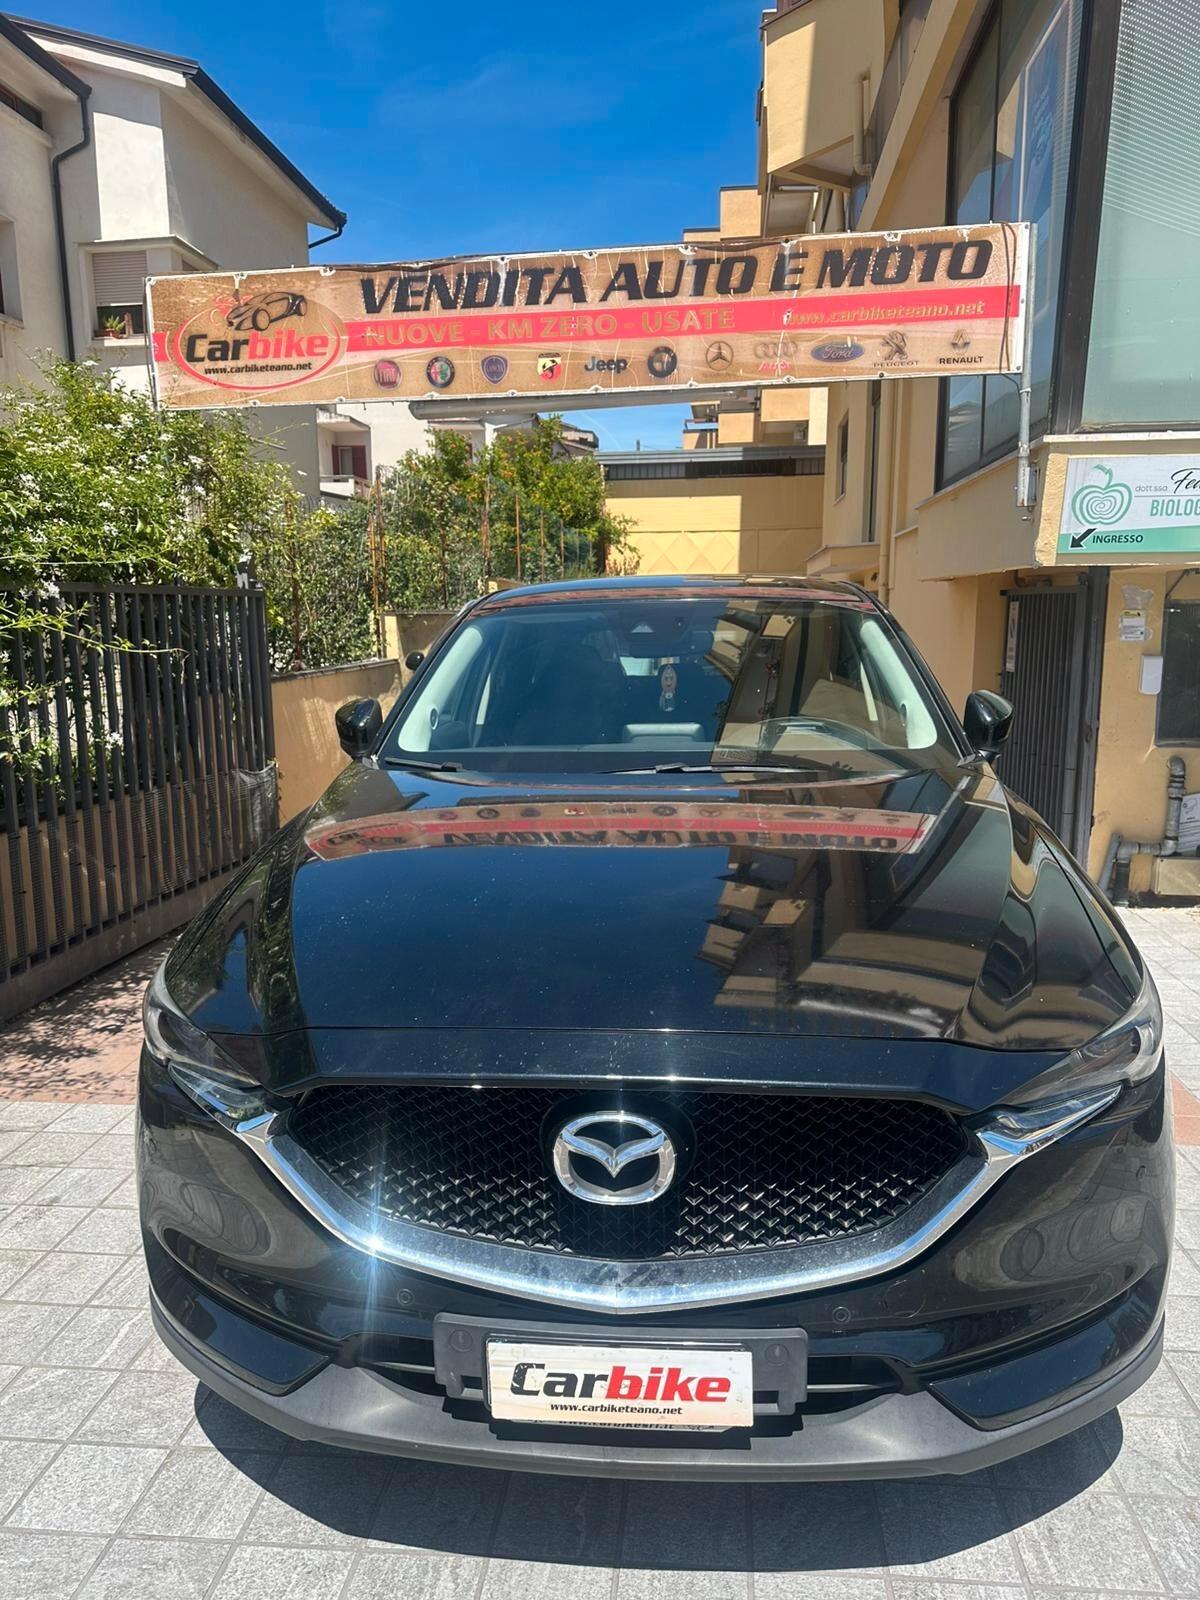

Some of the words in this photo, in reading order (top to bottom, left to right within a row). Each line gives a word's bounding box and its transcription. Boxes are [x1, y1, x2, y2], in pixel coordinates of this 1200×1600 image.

[360, 266, 587, 314] VENDITA
[599, 256, 758, 302] AUTO
[769, 250, 808, 292] E
[816, 239, 993, 289] MOTO
[365, 321, 464, 347] NUOVE
[487, 318, 533, 341] KM
[540, 314, 618, 338] ZERO
[642, 308, 735, 333] USATE
[186, 329, 329, 363] Carbike
[204, 362, 313, 375] www.carbiketeano.net
[584, 355, 629, 374] Jeep
[873, 359, 920, 368] PEUGEOT
[938, 355, 984, 365] RENAULT
[1092, 534, 1144, 544] INGRESSO
[510, 1362, 732, 1403] Carbike
[549, 1401, 683, 1416] www.carbiketeano.net
